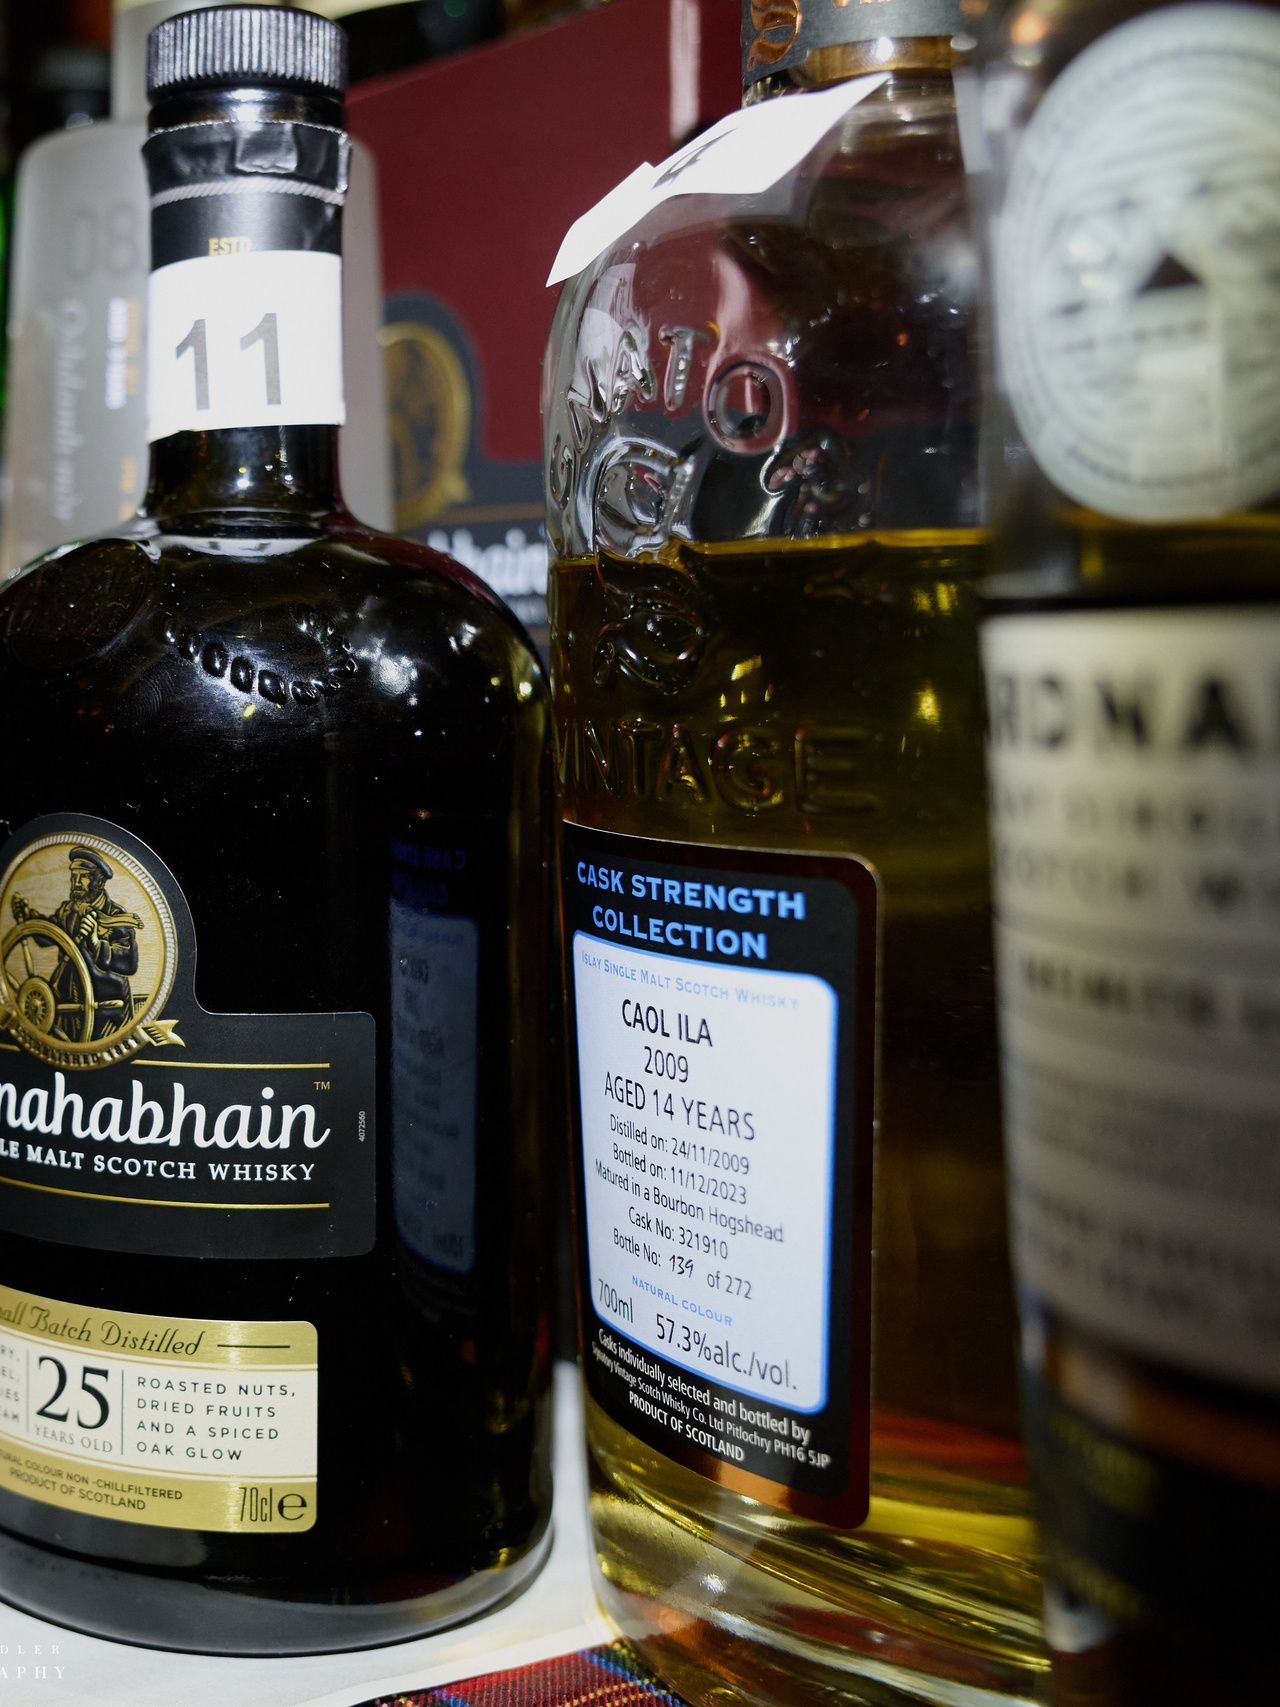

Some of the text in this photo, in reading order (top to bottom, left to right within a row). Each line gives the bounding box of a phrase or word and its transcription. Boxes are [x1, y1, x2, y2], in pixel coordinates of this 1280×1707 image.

[174, 312, 283, 411] 11
[577, 861, 806, 921] CASK STRENGTH
[592, 905, 768, 960] COLLECTION
[621, 998, 713, 1047] CAOL ILA
[644, 1046, 689, 1083] 2009
[604, 1072, 756, 1141] AGED 14 YEARS
[26, 1144, 85, 1171] MALT
[93, 1155, 196, 1180] SCOTCH
[210, 1163, 315, 1181] WHISKY
[610, 1114, 750, 1176] Distilled on: 24/11/2009
[613, 1143, 748, 1205] Bottled on: 11/12/2023
[595, 1158, 784, 1243] Matured in a Bourbon Hogshead
[628, 1206, 729, 1260] Cask No: 321910
[613, 1228, 753, 1300] Bottle No: 139 of 272
[598, 1278, 634, 1324] 700ml
[632, 1275, 733, 1326] NATURAL COLOUR
[30, 1306, 93, 1342] Batch
[101, 1320, 205, 1355] Distilled
[36, 1355, 111, 1430] 25
[138, 1376, 296, 1397] ROASTED NUTS,
[138, 1398, 276, 1418] DRIED FRUITS
[618, 1342, 666, 1388] individually
[667, 1376, 710, 1406] selected
[713, 1392, 736, 1416] and
[739, 1403, 788, 1436] bottled
[791, 1420, 811, 1446] by
[33, 1423, 113, 1453] YEARS OLD
[137, 1420, 279, 1440] AND A SPICED
[629, 1391, 745, 1462] PRODUCT OF SCOTLAND
[637, 1377, 661, 1401] Scotch
[661, 1391, 691, 1420] Whisky
[692, 1407, 707, 1425] Co.
[708, 1415, 724, 1432] Ltd
[726, 1422, 771, 1452] Pitlochry
[774, 1440, 804, 1462] PH16
[807, 1452, 832, 1470] 5JP
[24, 1459, 65, 1481] COLOUR
[66, 1471, 89, 1484] NON
[137, 1441, 243, 1461] OAK GLOW
[9, 1468, 146, 1511] PRODUCT OF SCOTLAND
[238, 1487, 273, 1522] 70cl
